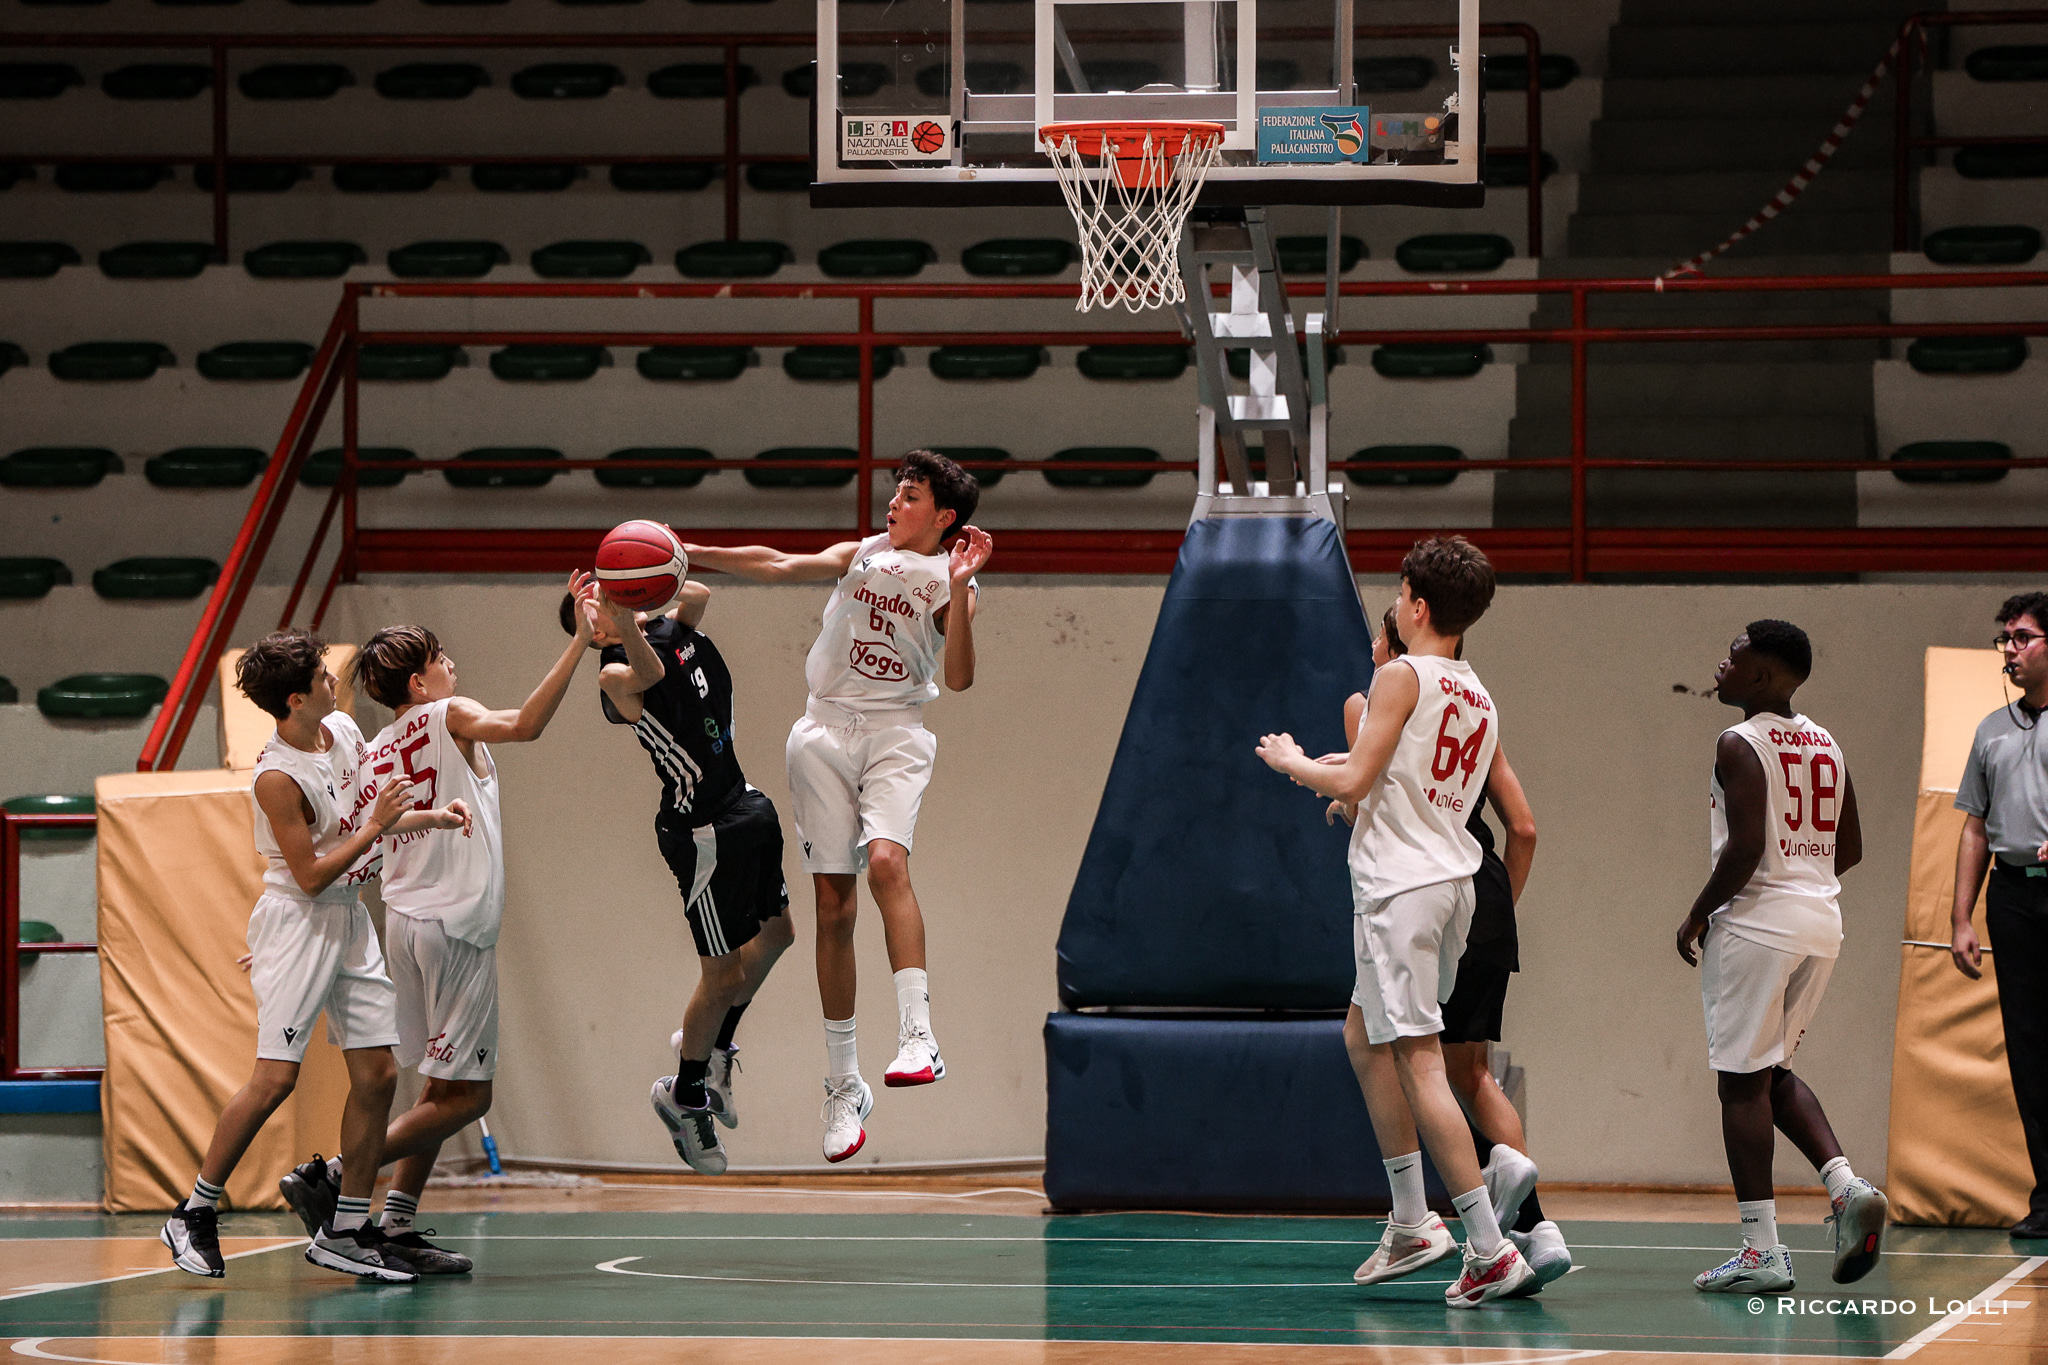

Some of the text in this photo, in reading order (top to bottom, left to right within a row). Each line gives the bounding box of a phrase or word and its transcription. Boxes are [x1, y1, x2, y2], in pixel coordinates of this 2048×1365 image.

[848, 121, 908, 137] LEGA
[1262, 115, 1316, 127] FEDERAZIONE
[951, 120, 961, 148] 1
[1289, 128, 1325, 140] ITALIANA
[847, 138, 908, 148] NAZIONALE
[1270, 143, 1334, 155] PALLACANESTRO
[1431, 702, 1488, 791] 64
[1783, 731, 1832, 748] CONAD
[1778, 752, 1838, 832] 58
